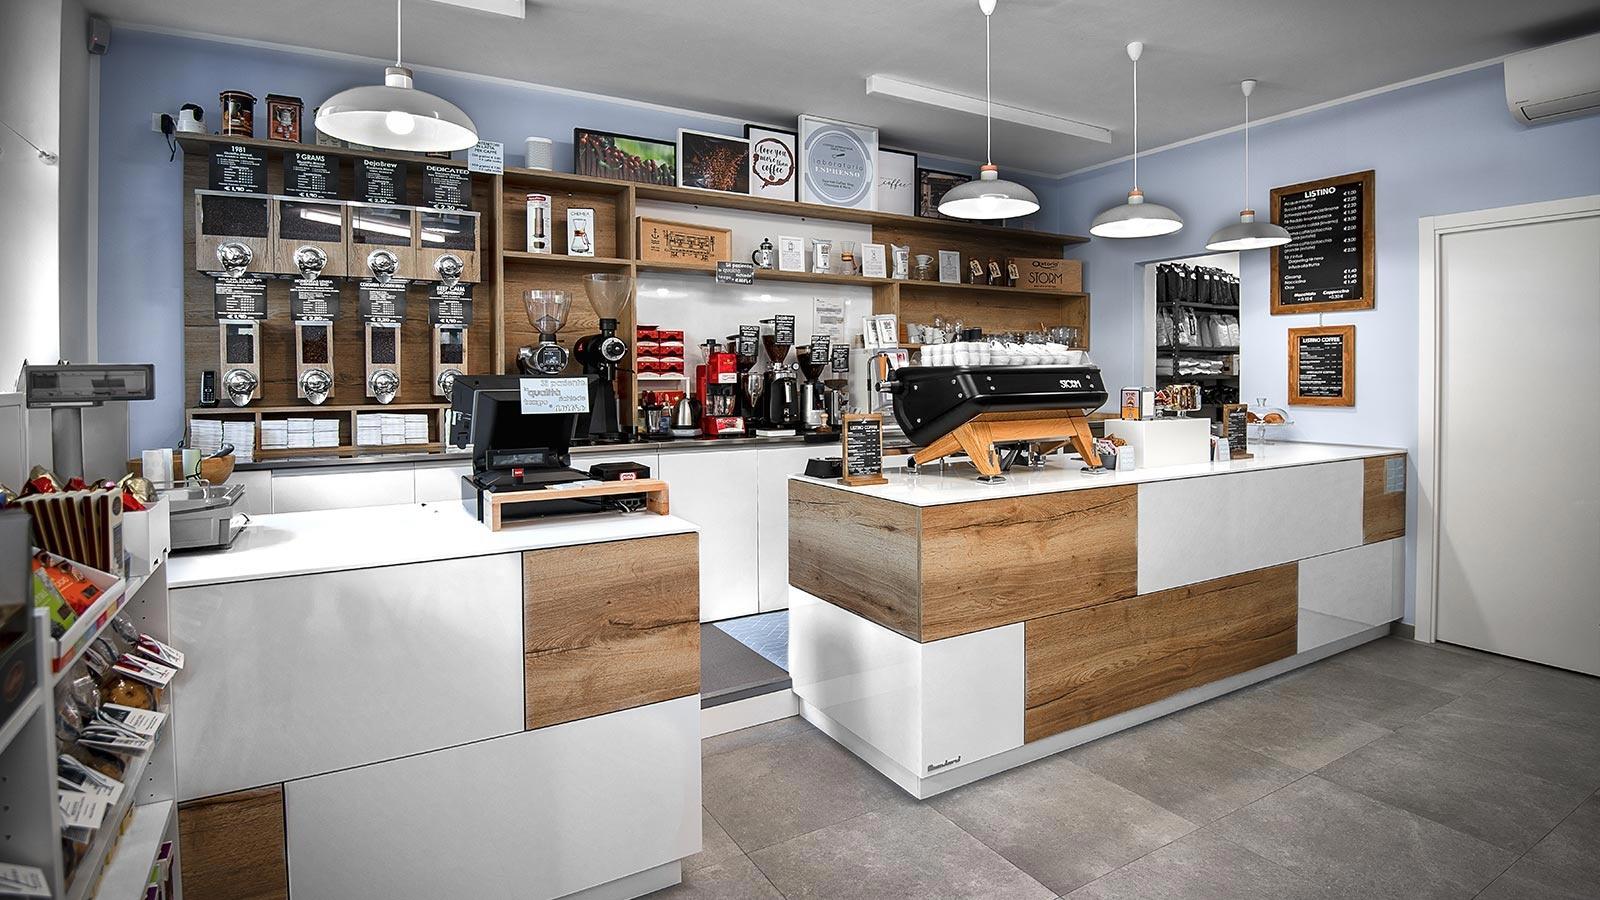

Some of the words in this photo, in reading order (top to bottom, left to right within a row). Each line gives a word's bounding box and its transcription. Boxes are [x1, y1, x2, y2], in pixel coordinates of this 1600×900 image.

[760, 145, 773, 154] love
[775, 150, 786, 158] you
[301, 154, 325, 162] GRAMS
[426, 165, 469, 174] DEDICATED
[762, 164, 782, 175] coffee
[815, 167, 860, 177] ESPRESSO
[880, 178, 909, 190] coffee
[1304, 187, 1336, 198] LISTINO
[1028, 271, 1063, 285] STORM
[1060, 379, 1081, 388] STORM
[528, 388, 561, 398] qualità
